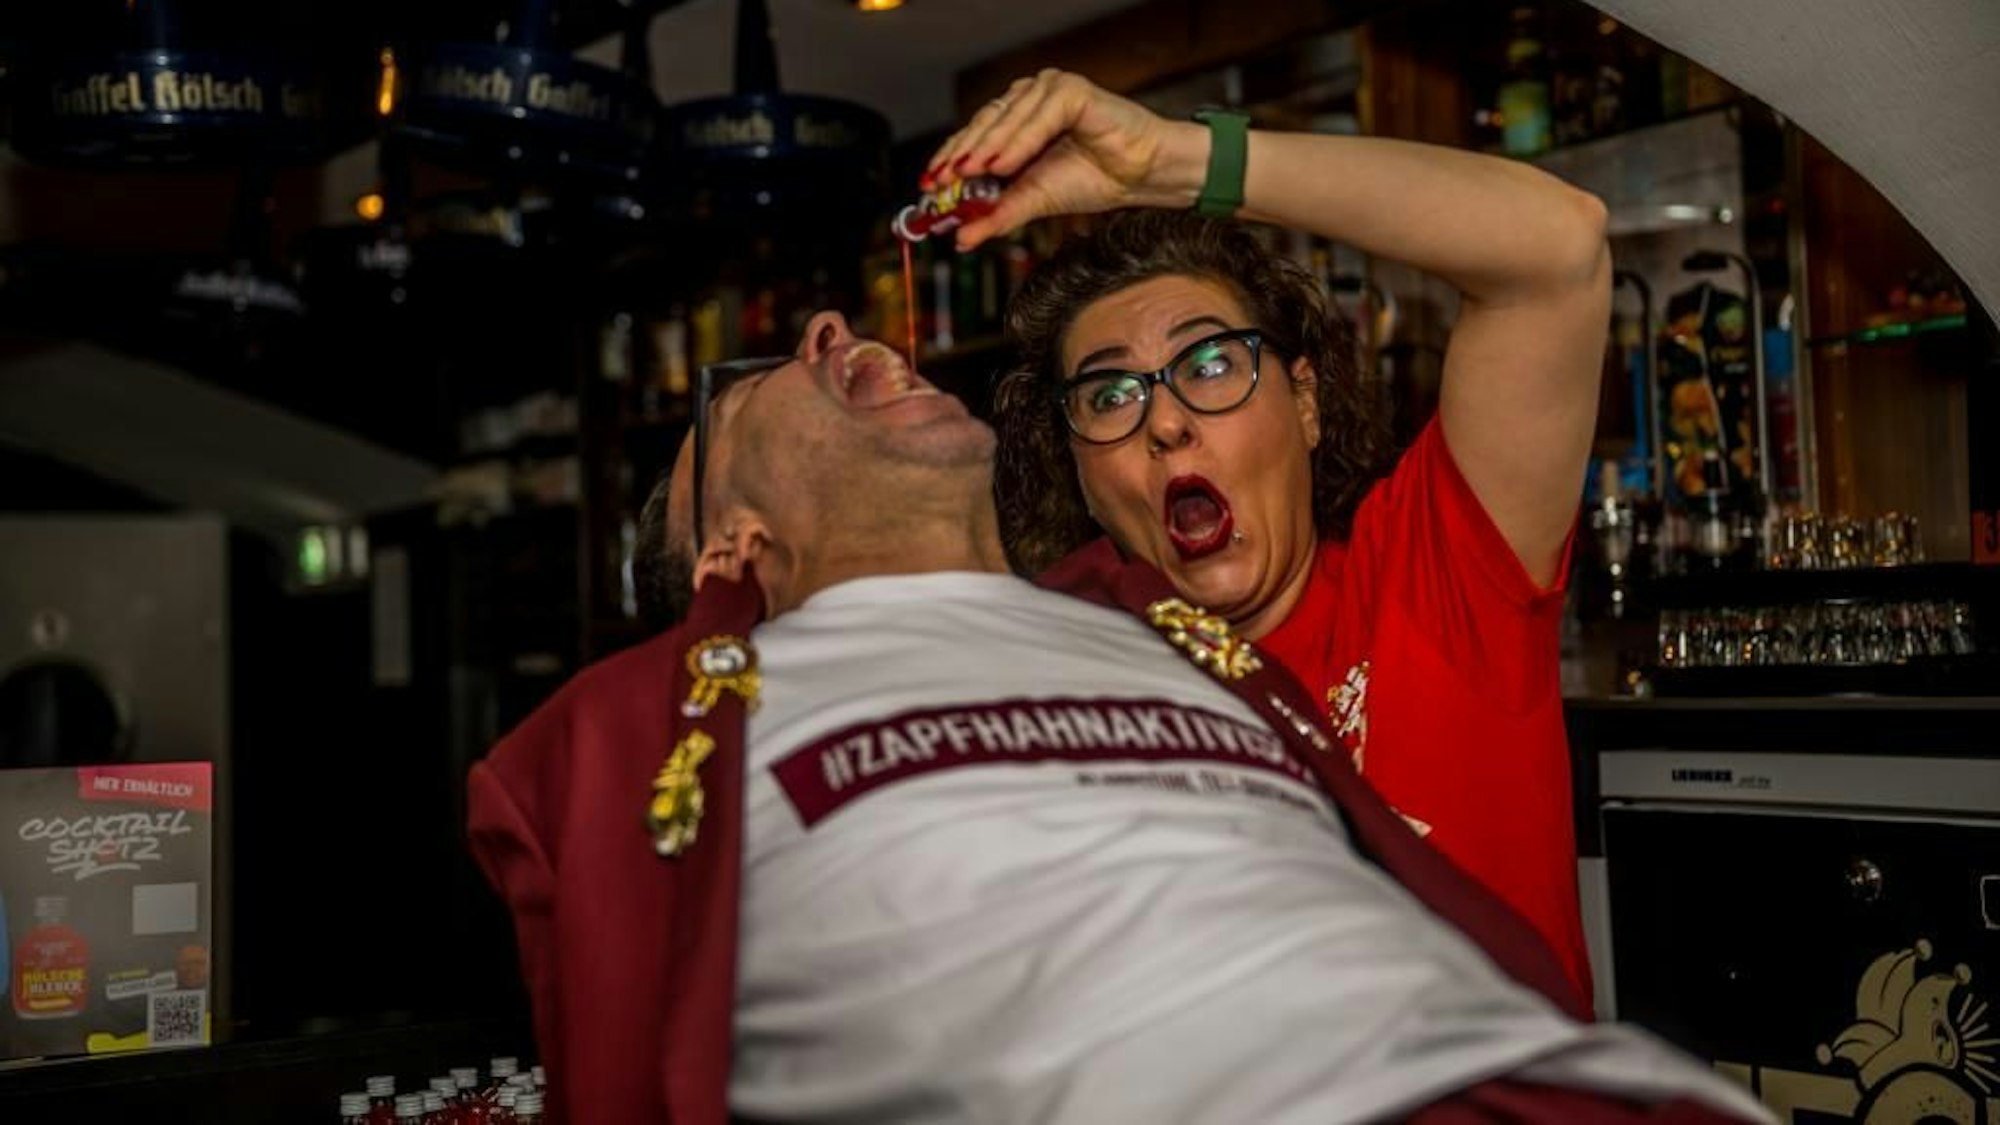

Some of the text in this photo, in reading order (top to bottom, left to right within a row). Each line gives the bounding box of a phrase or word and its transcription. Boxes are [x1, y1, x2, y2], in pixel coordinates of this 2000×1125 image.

[51, 70, 146, 117] Gaffel
[152, 70, 265, 113] Kölsch
[19, 809, 192, 842] COCKTAIL
